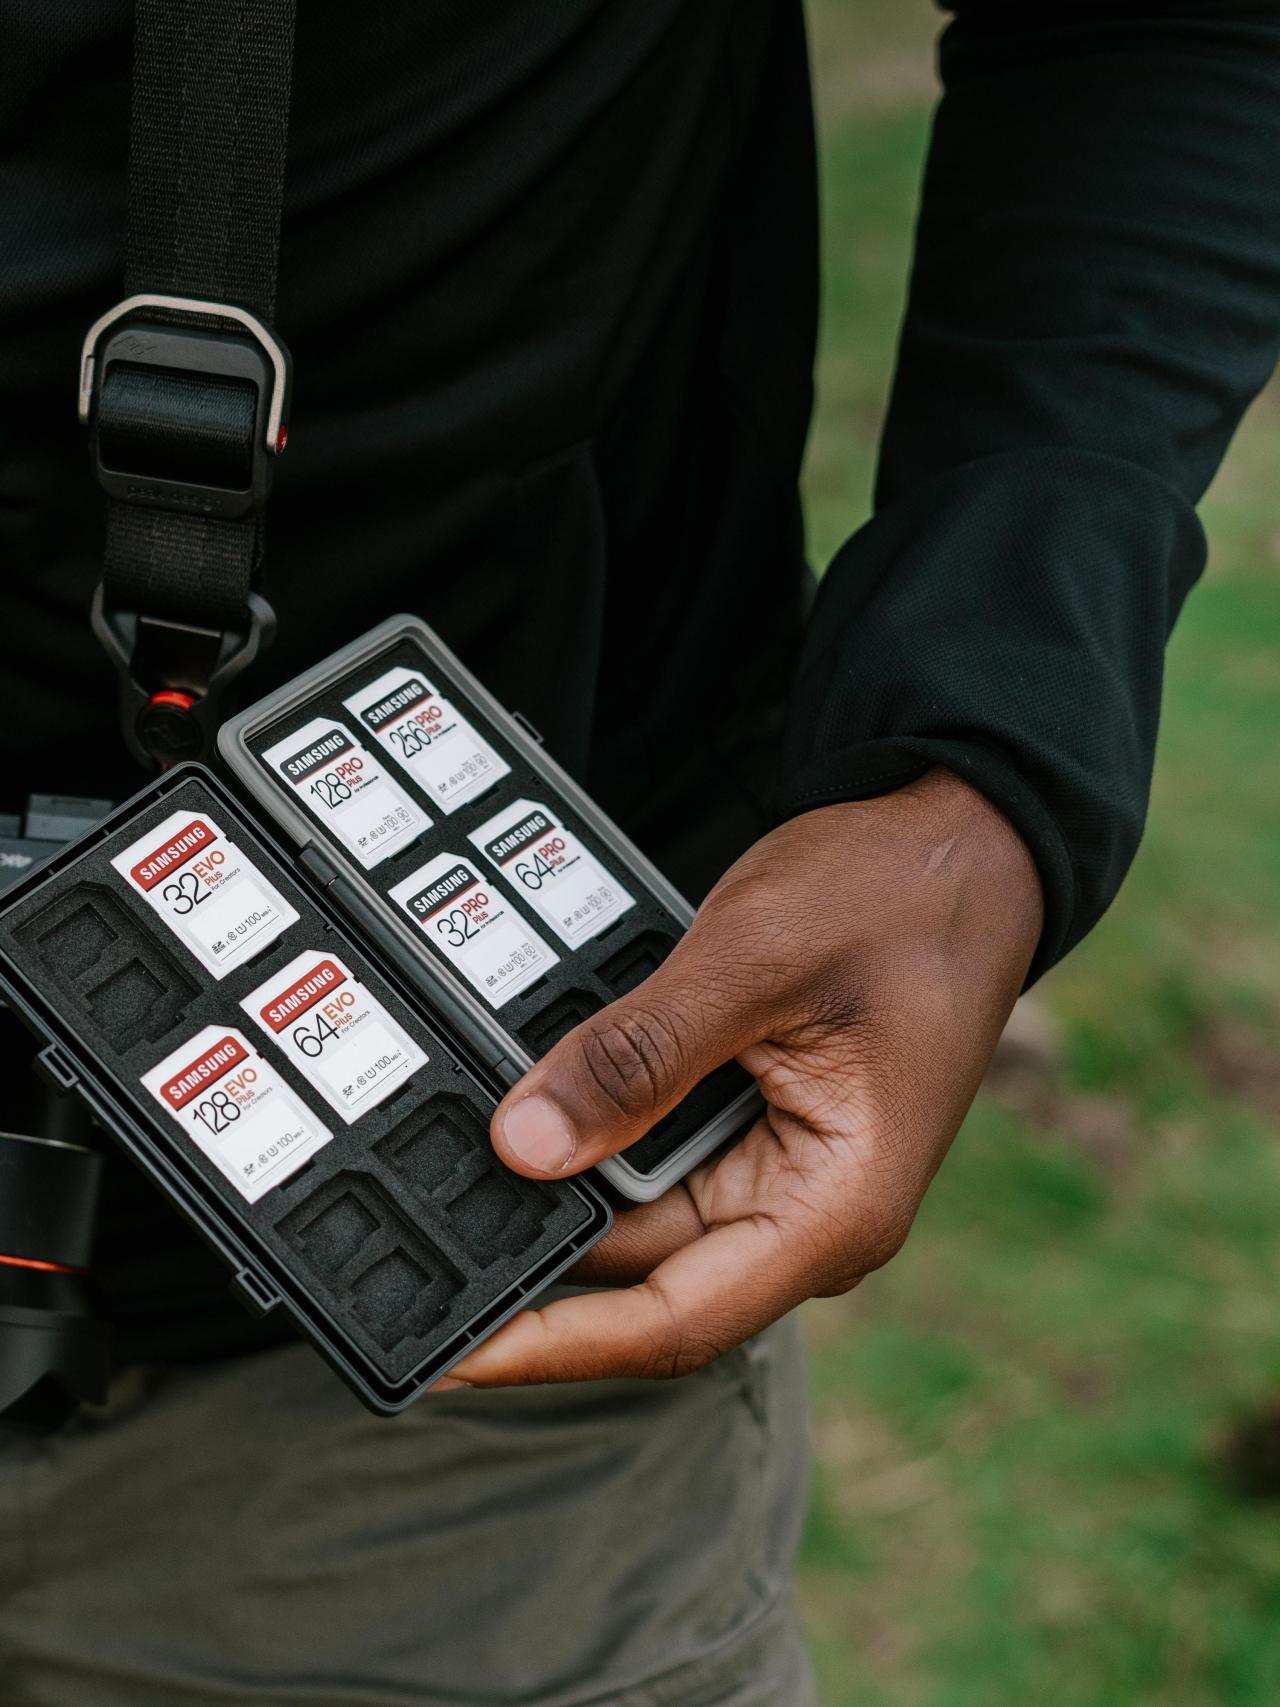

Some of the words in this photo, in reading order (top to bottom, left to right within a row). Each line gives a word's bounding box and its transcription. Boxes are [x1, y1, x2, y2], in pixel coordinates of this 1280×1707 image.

[368, 683, 423, 724] SAMSUNG
[389, 720, 431, 758] 256
[414, 705, 442, 728] PRO
[287, 734, 344, 776] SAMSUNG
[310, 773, 352, 810] 128
[335, 757, 364, 780] PRO
[346, 775, 363, 787] Plus
[139, 827, 206, 881] SAMSUNG
[492, 815, 547, 858] SAMSUNG
[163, 872, 212, 915] 32
[192, 850, 225, 879] EVO
[204, 871, 223, 887] Plus
[515, 853, 556, 890] 64
[538, 837, 566, 860] PRO
[413, 869, 469, 913] SAMSUNG
[245, 912, 262, 928] 100
[437, 910, 480, 947] 32
[461, 892, 489, 917] PRO
[472, 911, 489, 925] Plus
[269, 968, 335, 1023] SAMSUNG
[293, 1013, 340, 1058] 64
[322, 991, 355, 1021] EVO
[334, 1013, 353, 1030] Plus
[349, 1010, 371, 1028] Creators
[169, 1044, 237, 1100] SAMSUNG
[374, 1056, 392, 1071] 100
[193, 1091, 241, 1136] 128
[224, 1068, 257, 1097] EVO
[235, 1090, 256, 1106] Plus
[277, 1133, 294, 1149] 100
